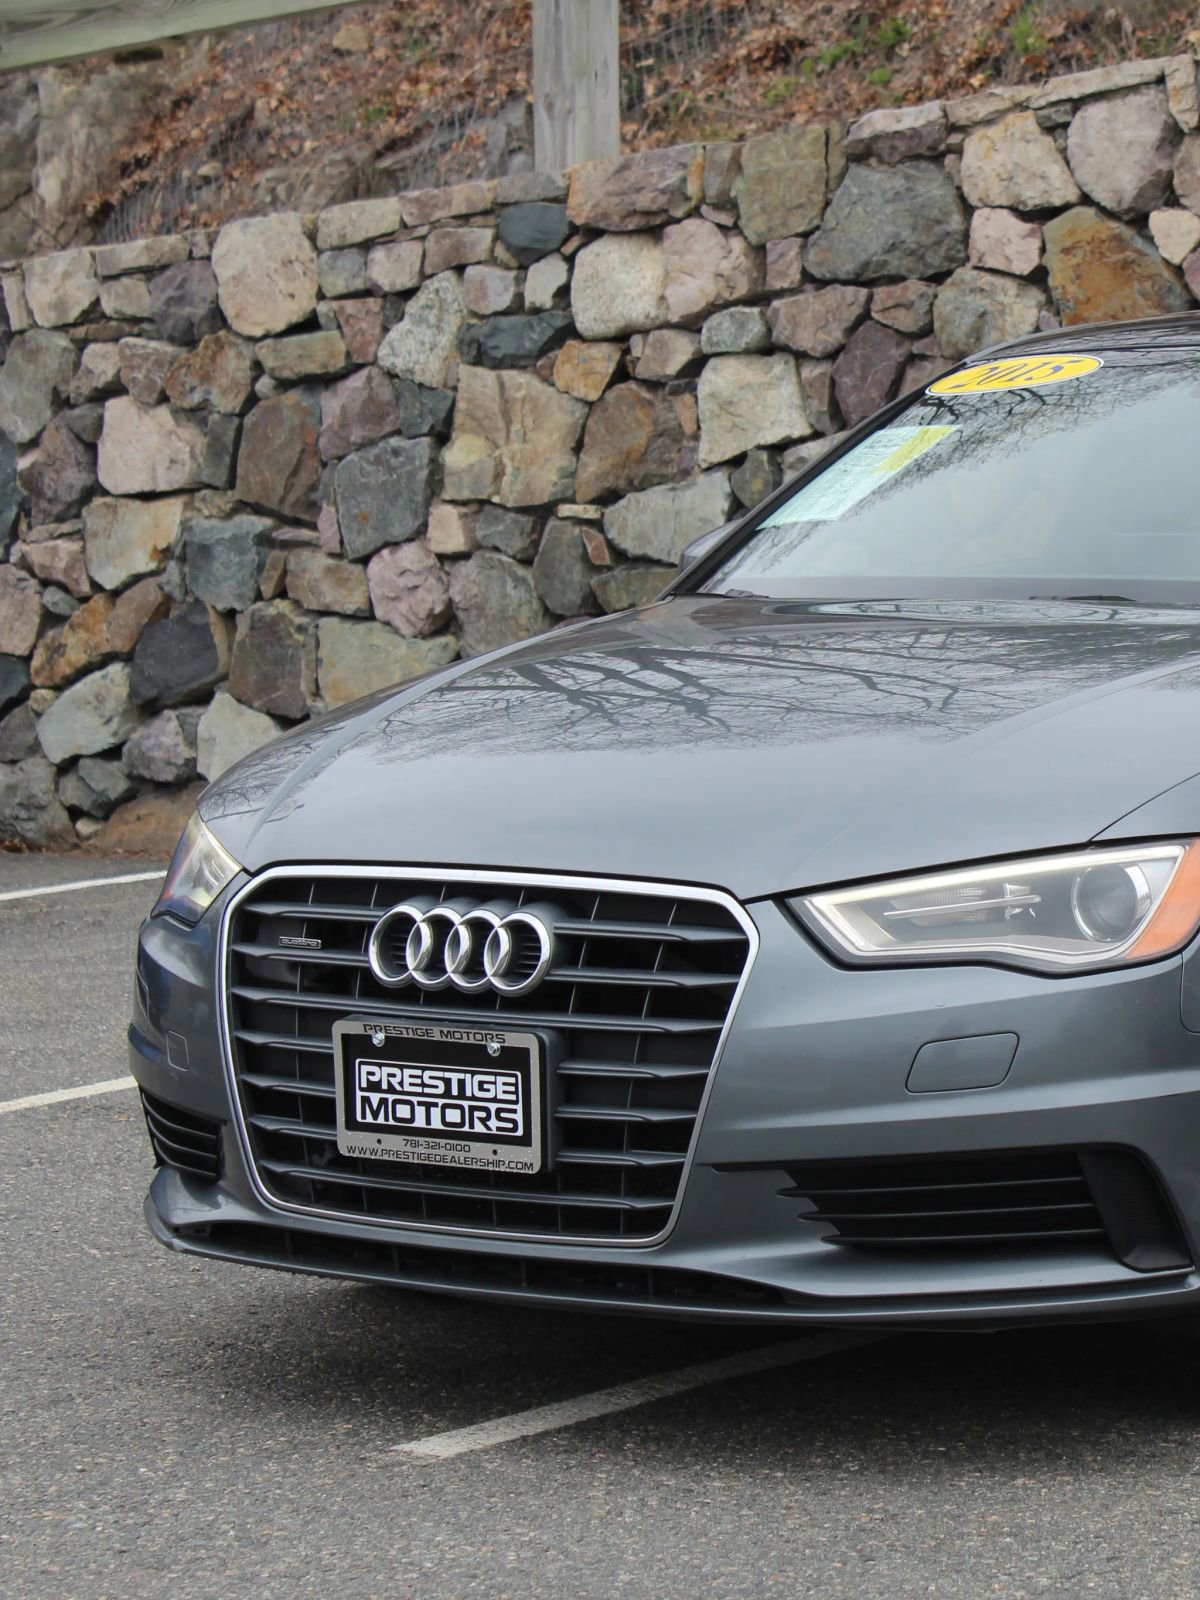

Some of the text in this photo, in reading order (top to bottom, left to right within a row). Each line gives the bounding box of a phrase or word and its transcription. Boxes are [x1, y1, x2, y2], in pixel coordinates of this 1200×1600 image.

[945, 359, 1085, 390] 2015
[363, 1023, 506, 1044] PRESTIGE MOTORS
[360, 1064, 517, 1101] PRESTIGE
[360, 1095, 519, 1134] MOTORS
[346, 1145, 534, 1171] WWW.PRESTIGEDEALERSHIP.COM
[402, 1138, 471, 1153] 781-321-0100
